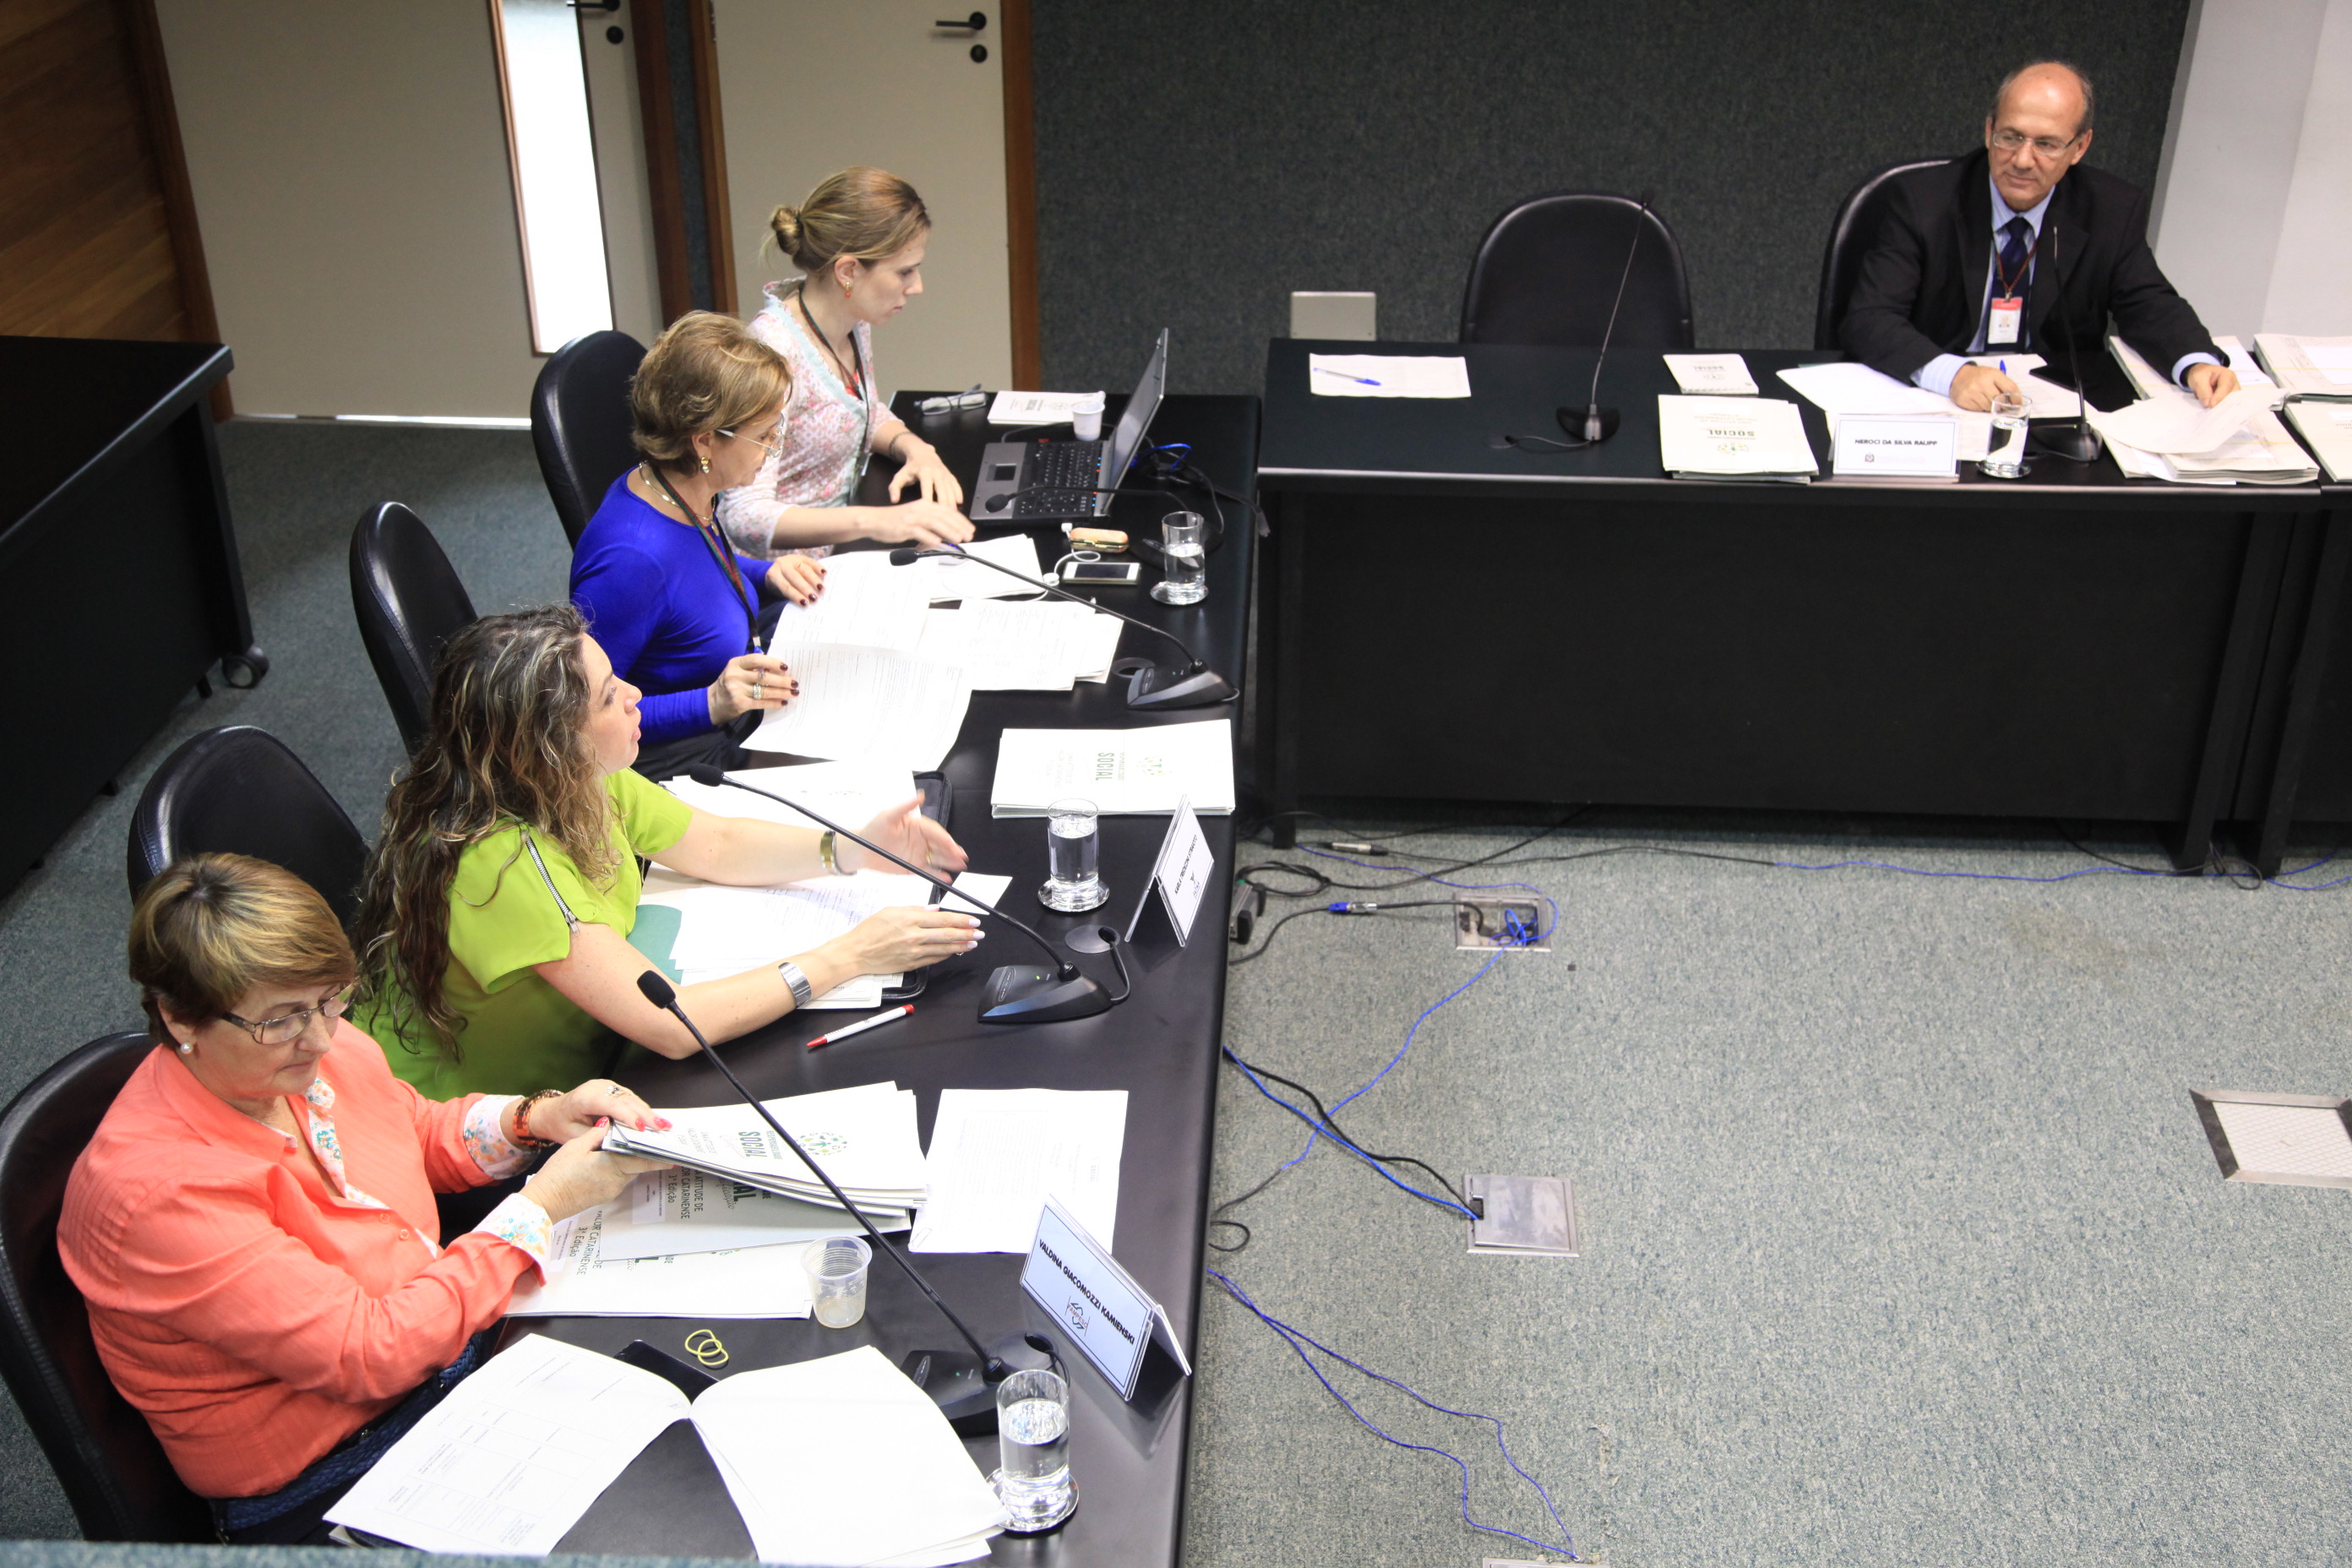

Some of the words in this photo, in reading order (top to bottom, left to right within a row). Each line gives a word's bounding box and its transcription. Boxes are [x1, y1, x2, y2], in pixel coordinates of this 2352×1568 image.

[1095, 752, 1115, 781] SOCIAL
[738, 1130, 768, 1158] SOCIAL
[665, 1182, 677, 1204] Edição
[680, 1178, 690, 1220] CATARINENSE
[694, 1176, 704, 1201] ATITUDE
[694, 1203, 704, 1212] DE
[569, 1235, 585, 1258] Edição
[576, 1232, 600, 1276] CATARINENSE
[1038, 1239, 1063, 1271] VALDINA
[1063, 1265, 1101, 1311] GIACOMOZZI
[1100, 1304, 1135, 1346] KAMIENSKI
